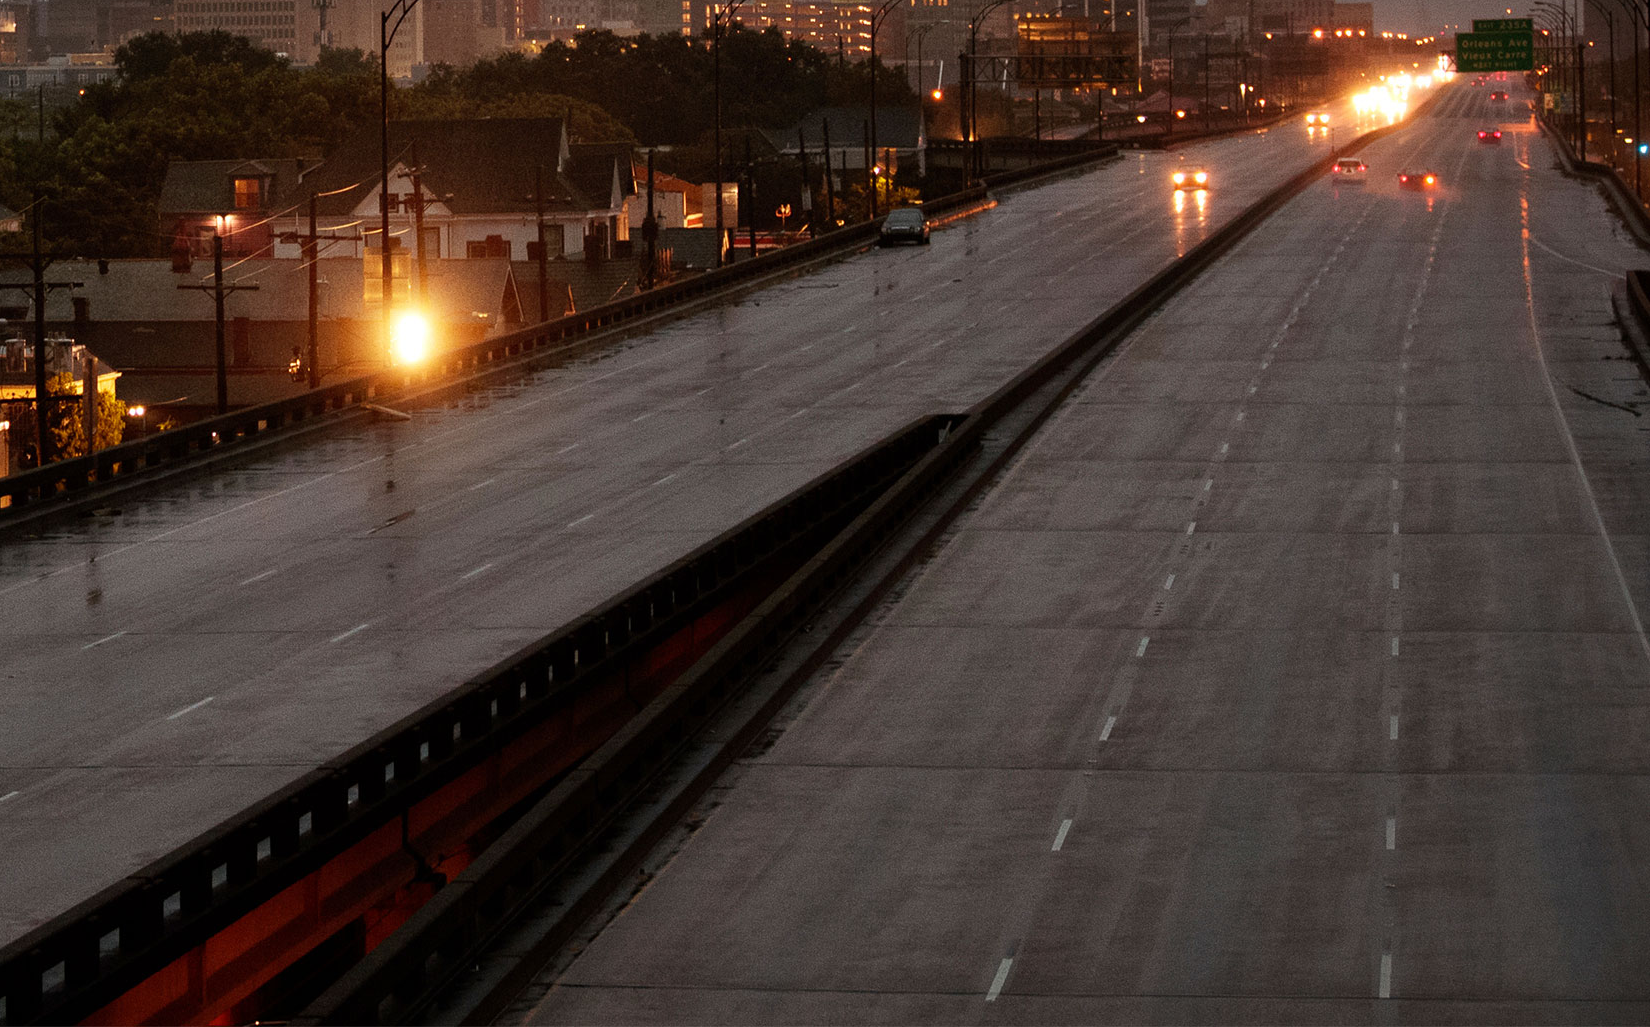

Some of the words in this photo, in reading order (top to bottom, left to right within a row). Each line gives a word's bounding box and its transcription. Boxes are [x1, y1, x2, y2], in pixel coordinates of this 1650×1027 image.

[1461, 39, 1503, 49] Orleans
[1508, 38, 1528, 48] Ave
[1461, 51, 1492, 60] Vieux
